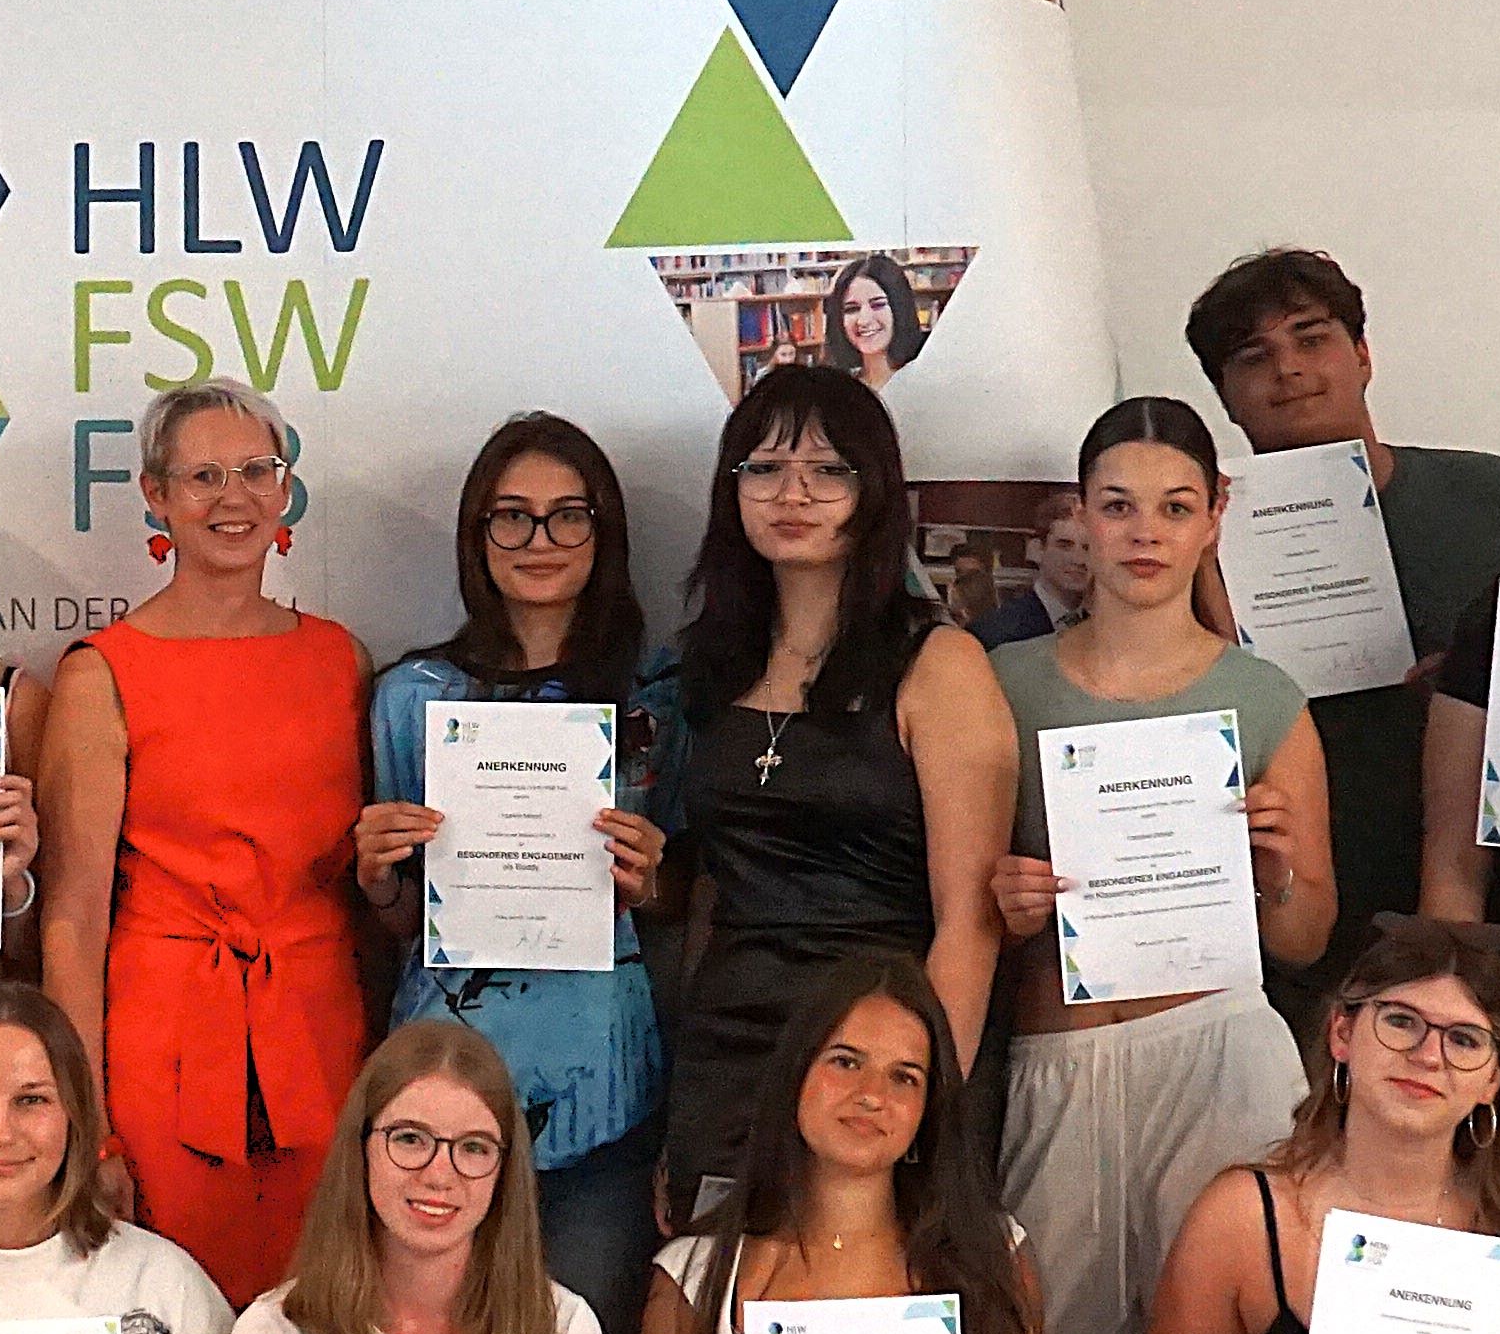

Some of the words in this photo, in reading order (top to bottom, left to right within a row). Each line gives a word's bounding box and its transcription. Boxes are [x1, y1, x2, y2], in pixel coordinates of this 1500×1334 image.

[73, 139, 385, 254] HLW
[73, 277, 370, 393] FSW
[1252, 498, 1334, 518] ANERKENNUNG
[476, 760, 567, 773] ANERKENNUNG
[1098, 775, 1193, 794] ANERKENNUNG
[457, 850, 519, 861] BESONDERES
[521, 851, 585, 861] ENGAGEMENT
[1088, 873, 1154, 888] BESONDERES
[1389, 1287, 1473, 1312] ANERKENNUNG
